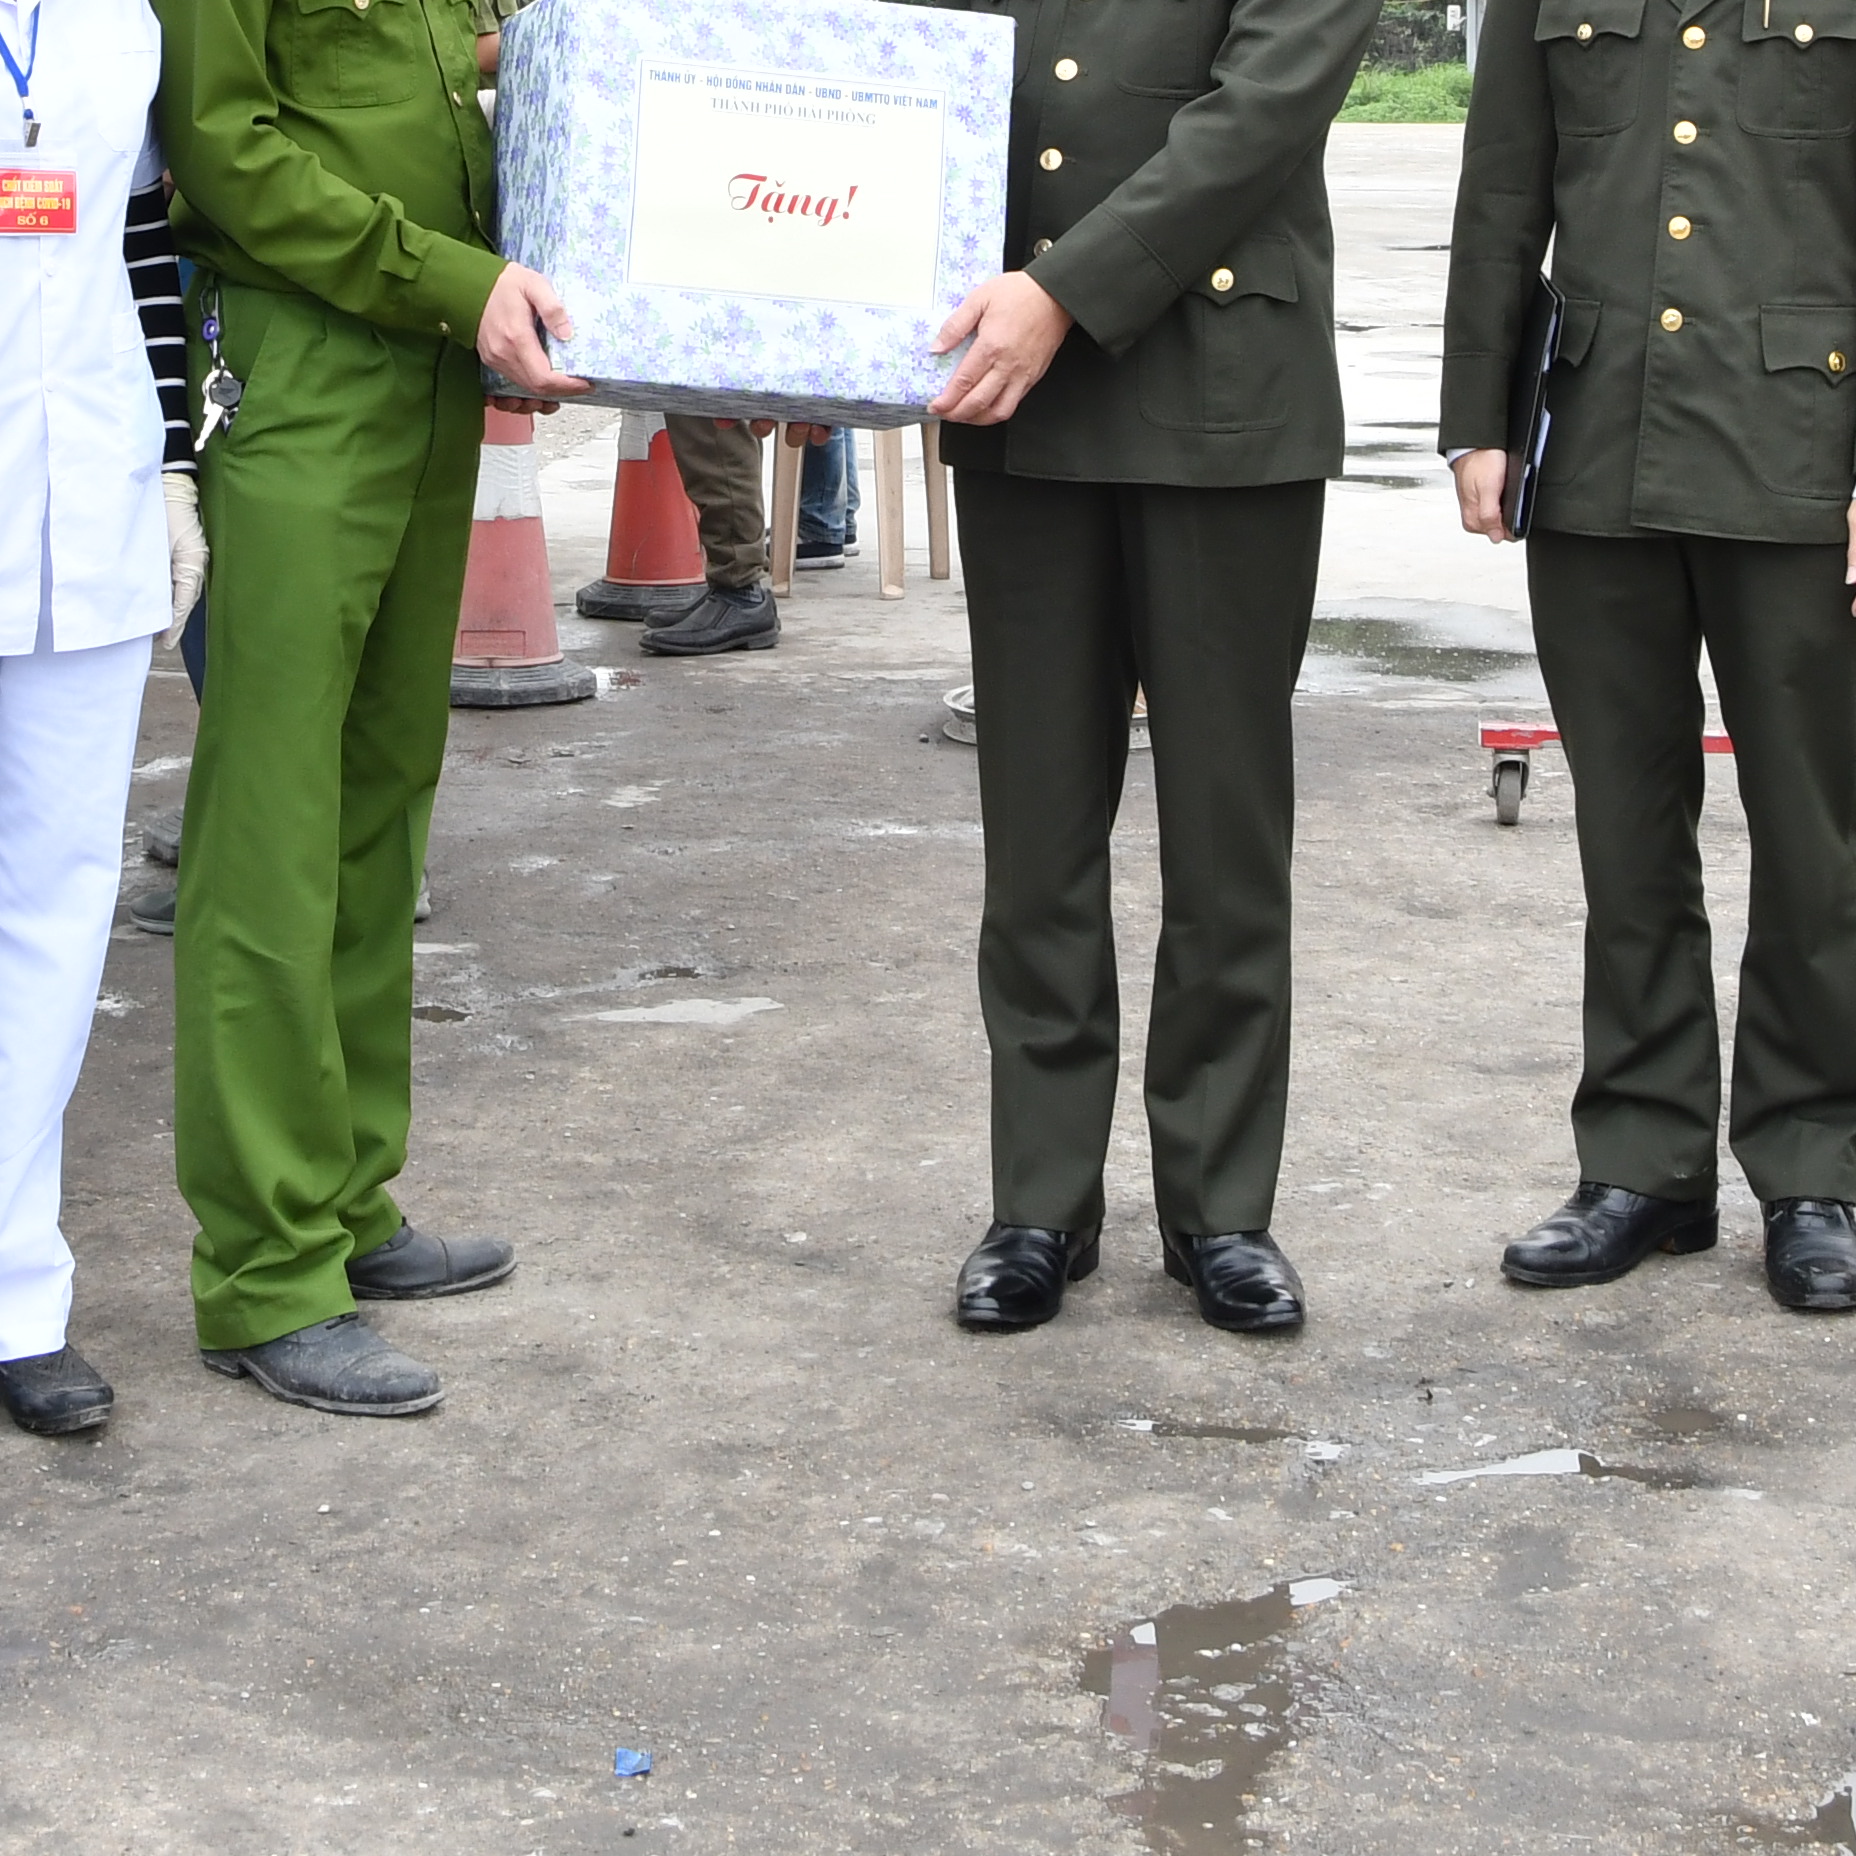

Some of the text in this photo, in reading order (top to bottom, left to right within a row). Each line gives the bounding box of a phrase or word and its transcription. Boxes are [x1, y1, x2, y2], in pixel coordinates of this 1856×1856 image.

[711, 96, 760, 113] THÀNH
[815, 87, 842, 100] UBND
[851, 91, 890, 106] UBMTTQ
[893, 94, 913, 109] VIỆT
[916, 98, 938, 109] NAM
[728, 173, 858, 227] Tặng!
[17, 211, 49, 226] SỐ 6
